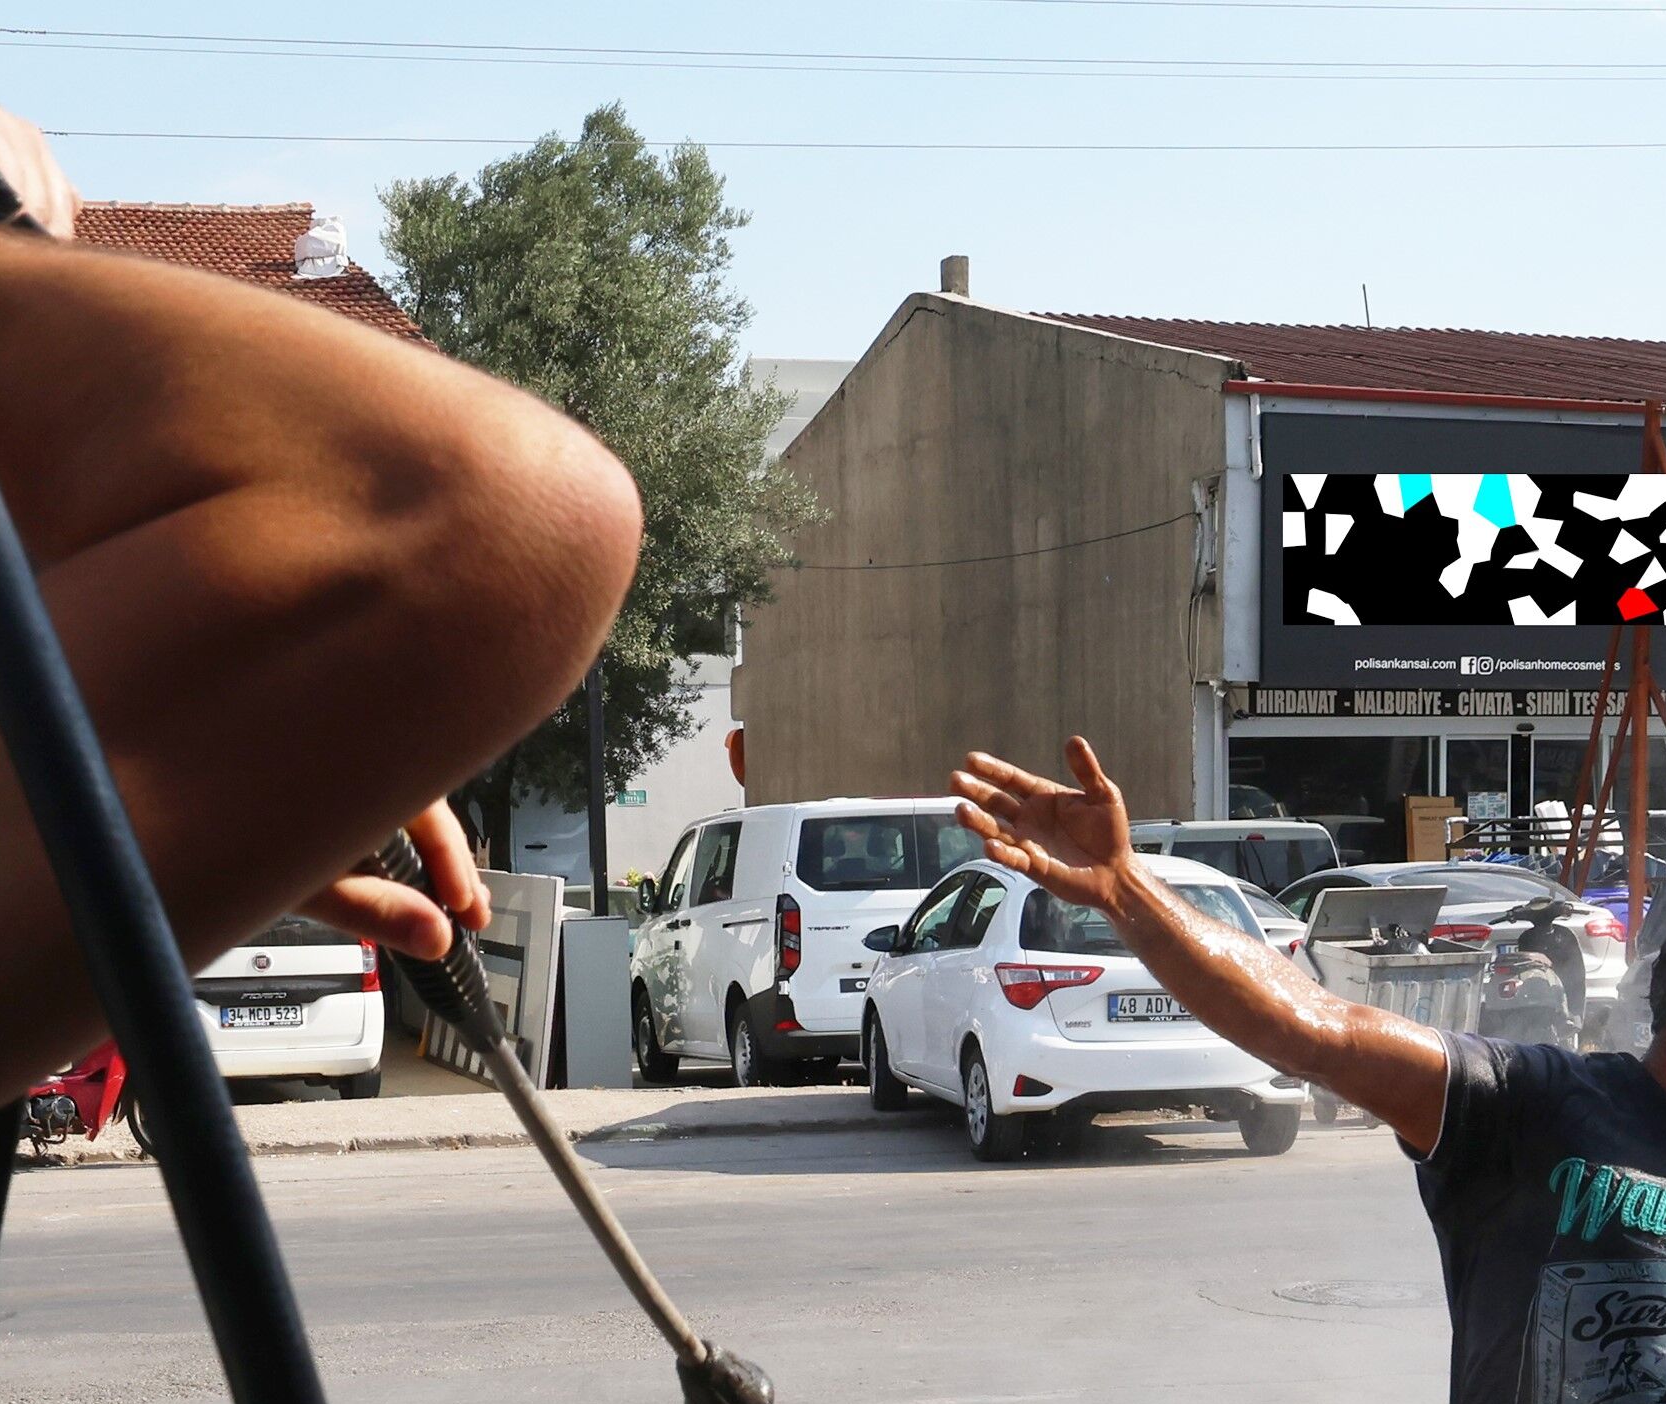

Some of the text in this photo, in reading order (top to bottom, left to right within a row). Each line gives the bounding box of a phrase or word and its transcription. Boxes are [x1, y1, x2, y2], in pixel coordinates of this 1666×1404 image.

[1354, 658, 1457, 673] polisankansai.com
[1255, 689, 1338, 714] HIRDAVAT
[1353, 687, 1443, 715] NALBURİYE
[1457, 688, 1514, 716] CİVATA
[1119, 997, 1137, 1014] 48
[1145, 997, 1173, 1014] ADY
[229, 1008, 243, 1021] 34
[275, 1007, 298, 1020] 523
